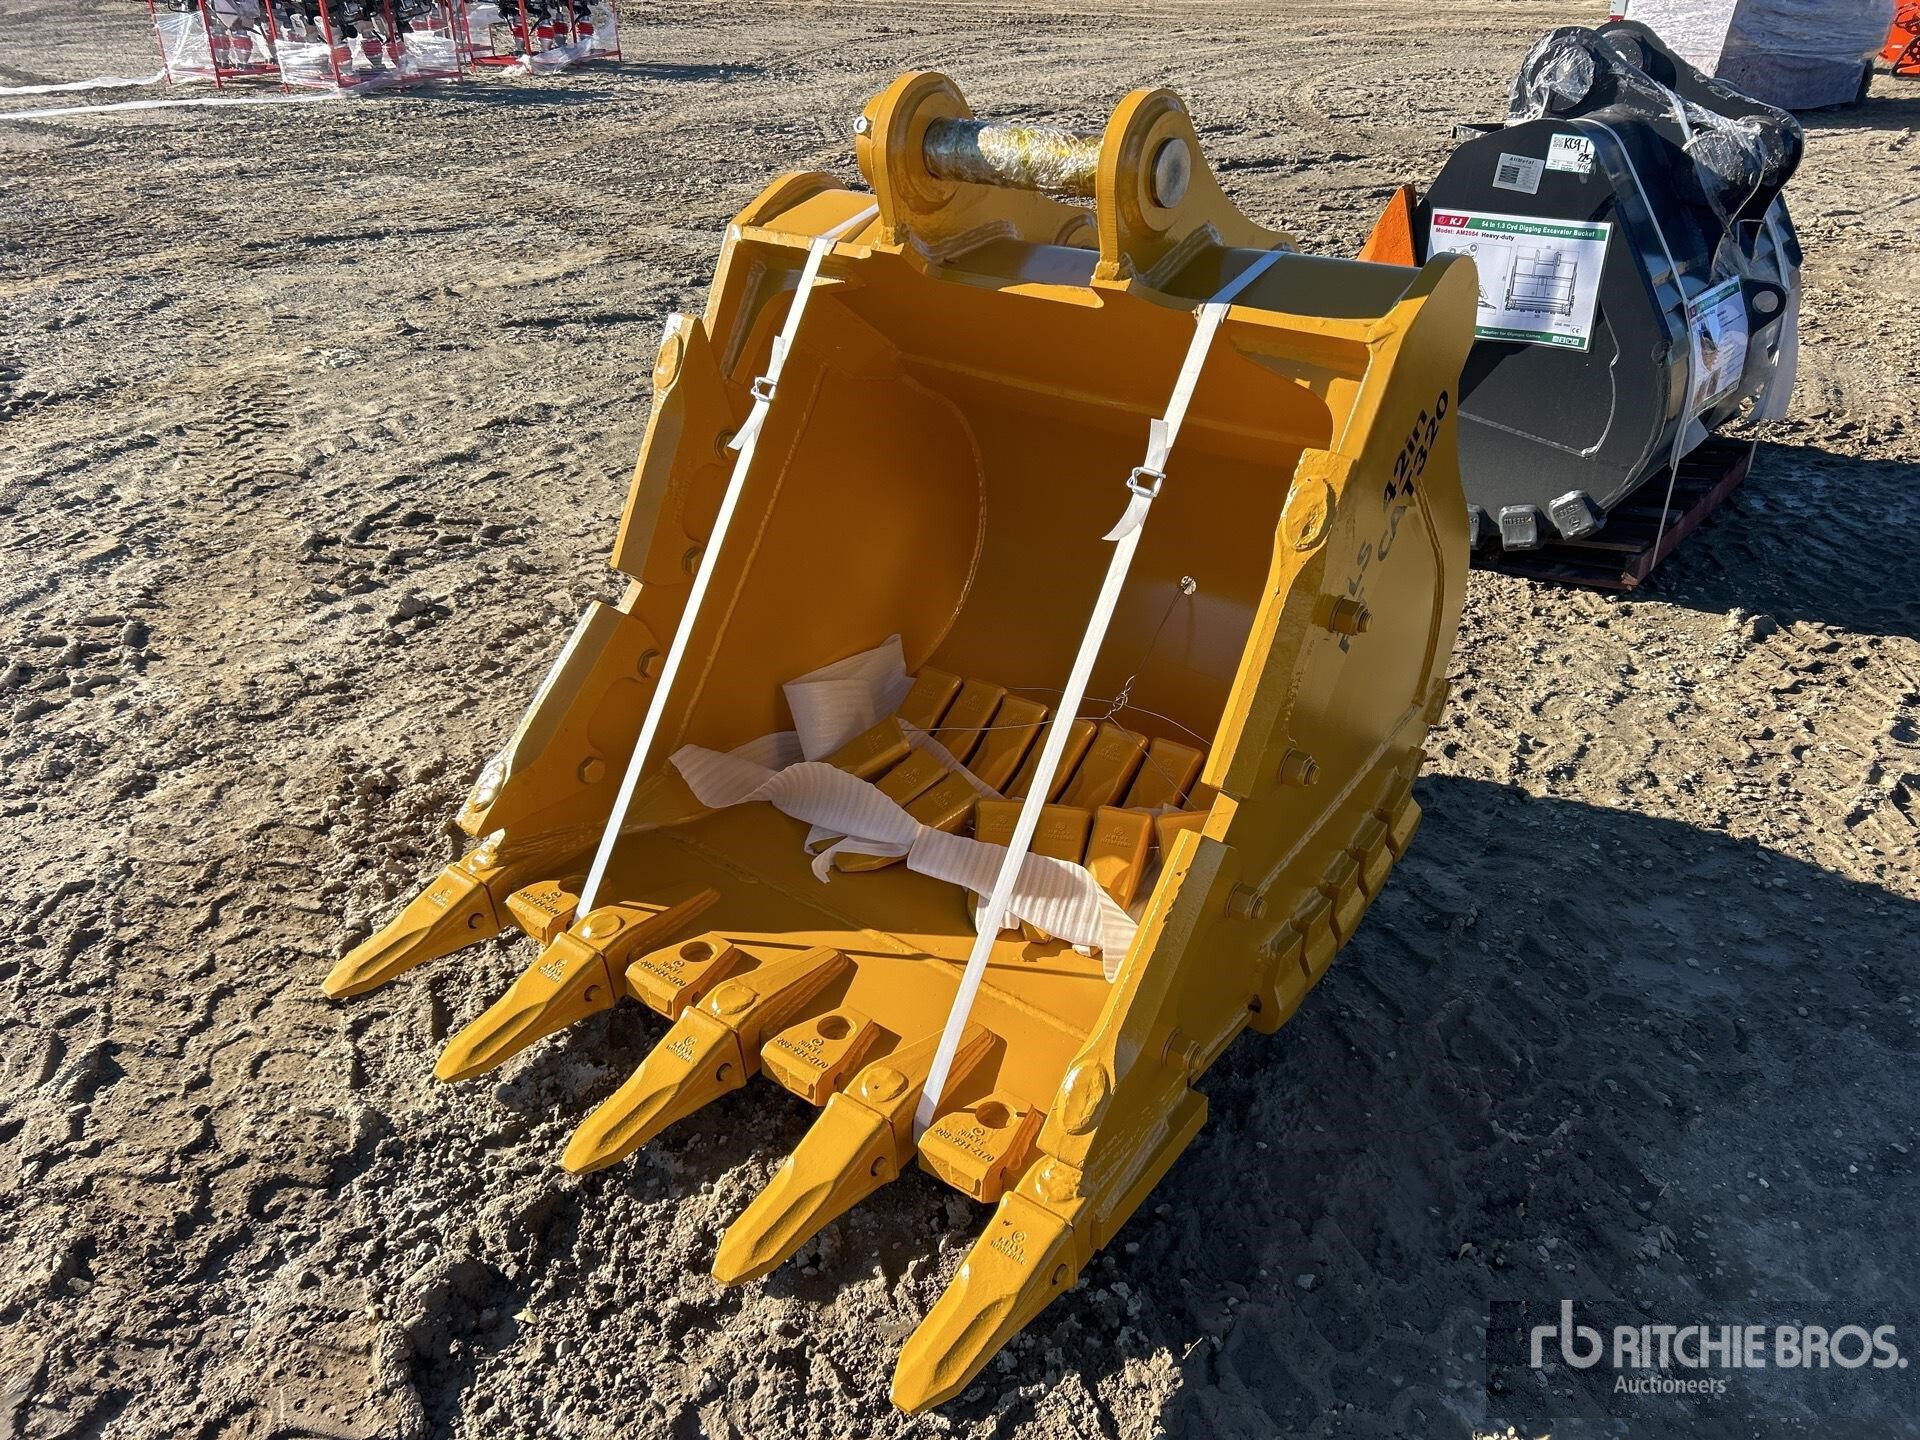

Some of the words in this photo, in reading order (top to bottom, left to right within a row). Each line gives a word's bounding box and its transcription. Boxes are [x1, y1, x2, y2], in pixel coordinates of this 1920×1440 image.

[1449, 216, 1463, 226] KJ
[1435, 227, 1454, 235] Model:
[1481, 232, 1515, 241] Heavy-duty
[1481, 220, 1489, 228] 54
[1506, 223, 1518, 231] Cyd
[1519, 224, 1542, 234] Digging
[1543, 226, 1572, 236] Excavator
[1573, 229, 1595, 238] Bucket
